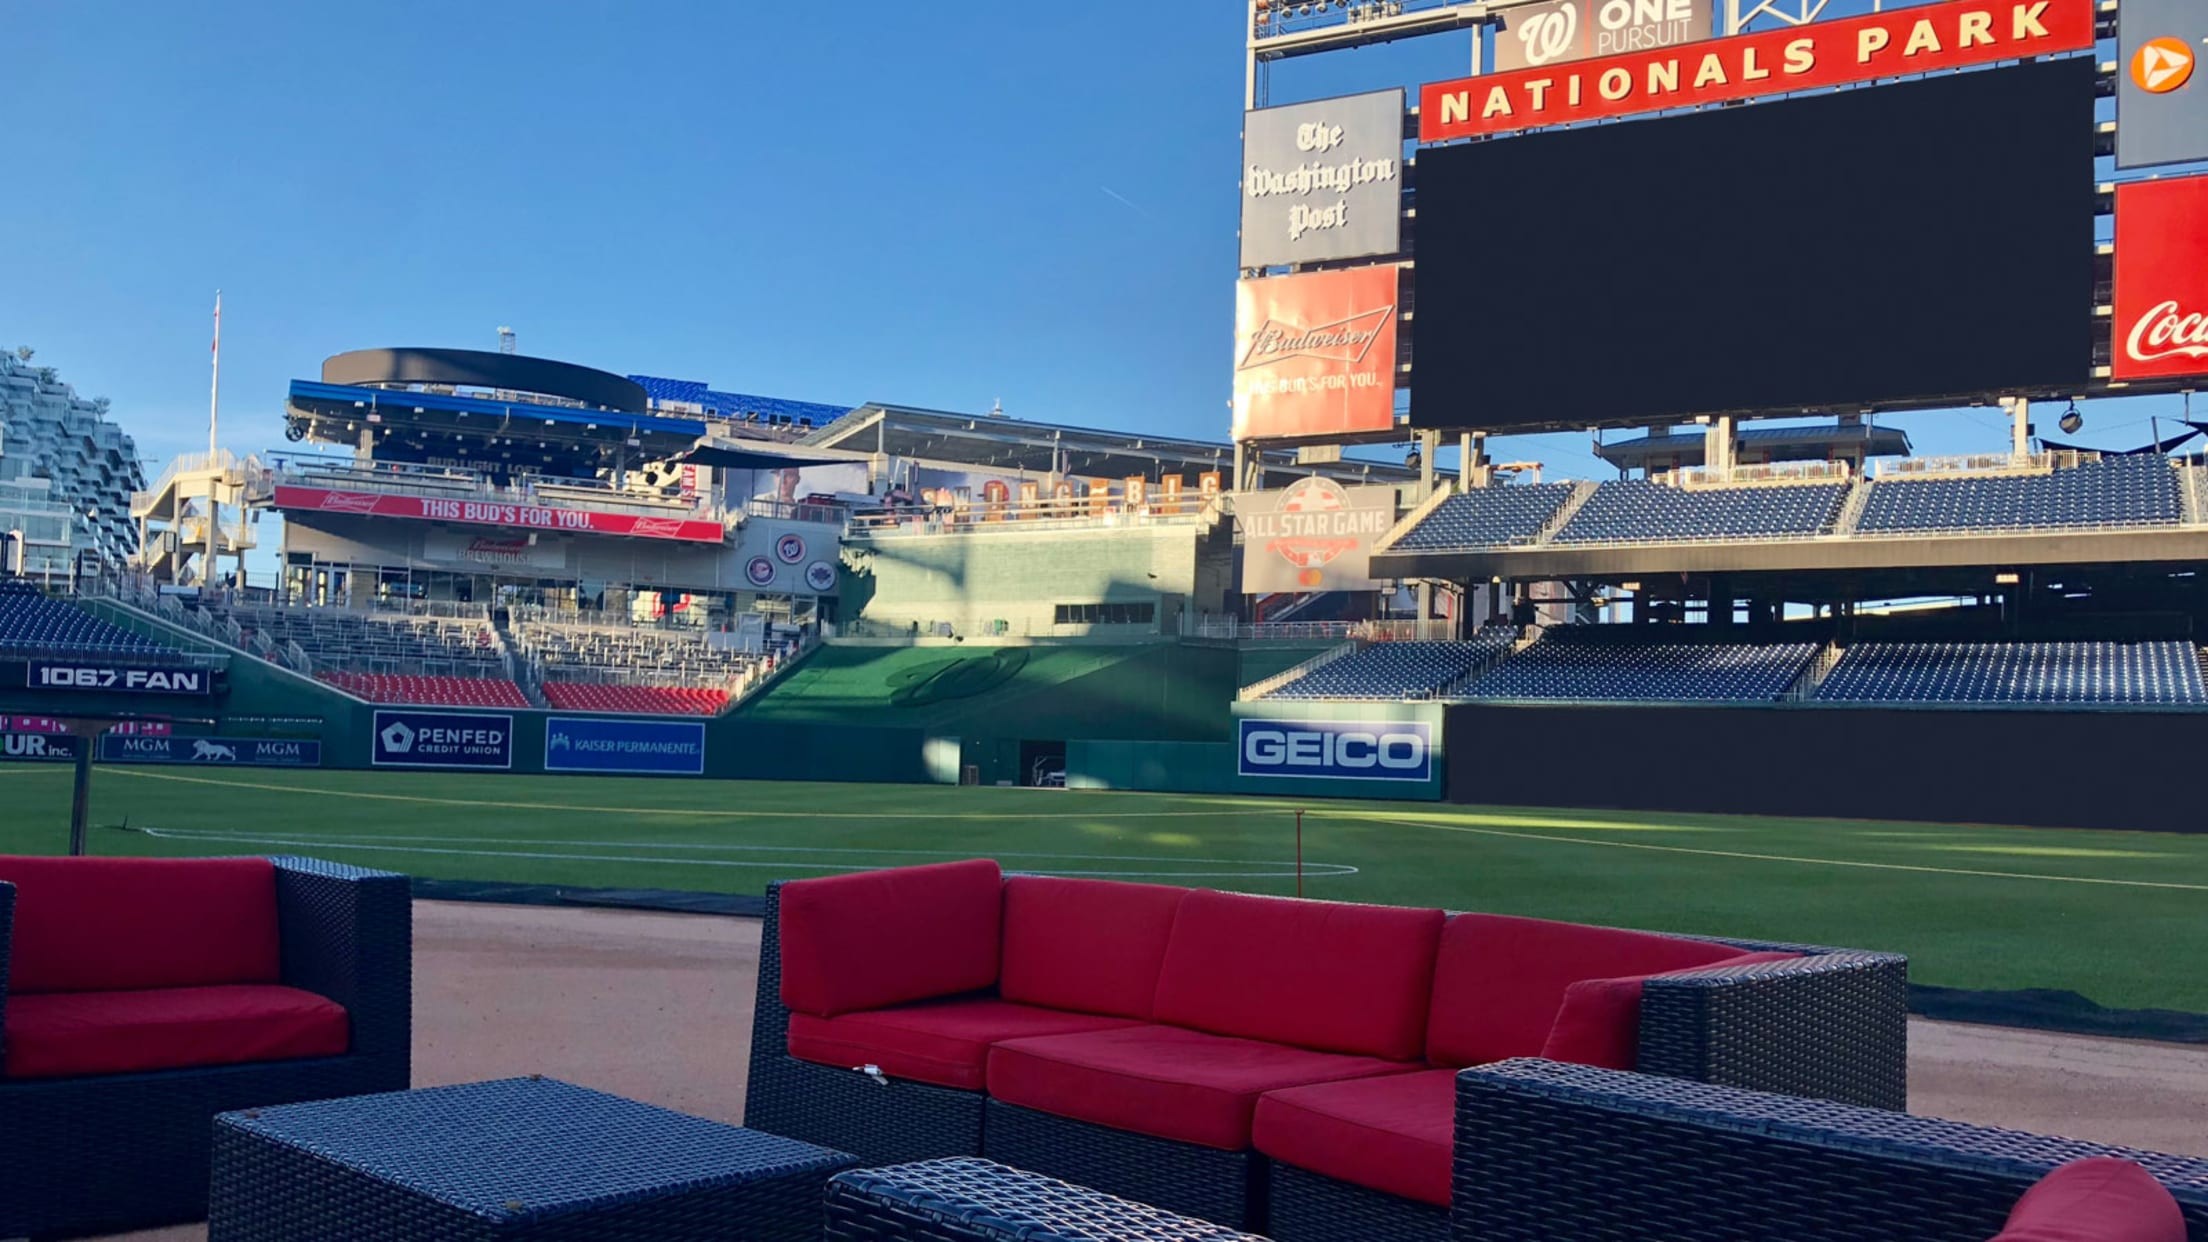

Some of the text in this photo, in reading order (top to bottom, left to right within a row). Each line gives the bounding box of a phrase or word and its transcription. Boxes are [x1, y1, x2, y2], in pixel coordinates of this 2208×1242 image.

[1599, 0, 1694, 31] ONE
[1598, 19, 1693, 56] PURSUIT
[1441, 1, 2051, 124] NATIONALS PARK
[1297, 121, 1344, 151] The
[1247, 158, 1395, 197] Washington
[1289, 201, 1348, 241] Post
[1251, 327, 1376, 356] Budweiser
[1321, 376, 1346, 389] FOR
[421, 500, 594, 529] THIS BUD'S FOR YOU.
[1244, 510, 1385, 538] ALL STAR GAME
[40, 667, 198, 690] 106.7 FAN
[0, 734, 46, 755] UR
[124, 739, 169, 752] MGM
[256, 742, 299, 755] MGM
[418, 744, 500, 754] CREDIT UNION
[419, 728, 502, 744] PENFED
[575, 739, 615, 752] KAISER
[1245, 731, 1424, 769] GEICO
